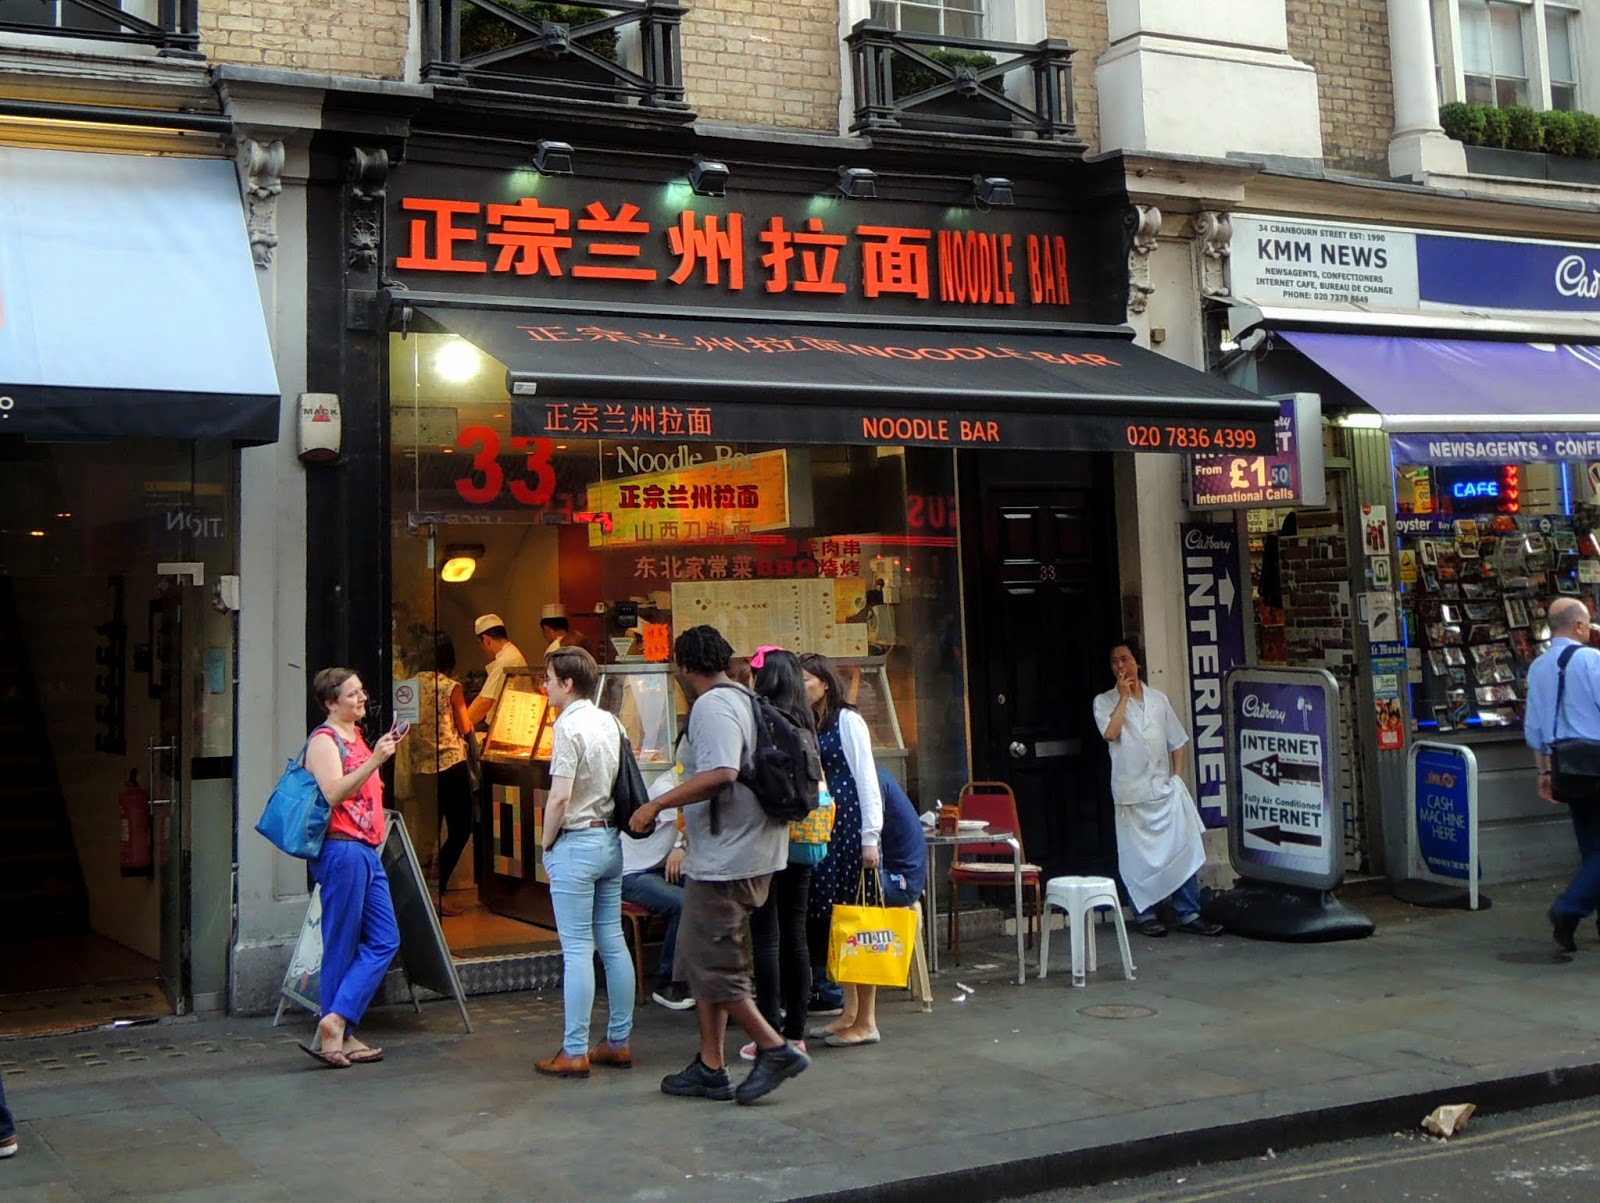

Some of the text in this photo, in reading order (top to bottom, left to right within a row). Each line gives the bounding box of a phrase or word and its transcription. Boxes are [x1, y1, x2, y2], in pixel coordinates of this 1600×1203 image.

[1258, 224, 1268, 232] 34
[1270, 225, 1318, 237] CRANBOURN
[1320, 229, 1347, 239] STREET
[1367, 234, 1386, 242] 1990
[396, 197, 1070, 305] 正宗兰州拉面 NOODLE BAR
[1257, 238, 1388, 269] KMM NEWS
[1256, 277, 1294, 287] INTERNET
[1296, 281, 1317, 290] CAFE,
[1319, 282, 1350, 292] BUREAU
[1363, 286, 1393, 295] CHANGE
[1265, 267, 1383, 283] NEWSAGENTS, CONFECTIONERS
[1283, 290, 1312, 299] PHONE:
[1313, 292, 1328, 300] 020
[1330, 293, 1349, 303] 7379
[516, 324, 1122, 368] 正宗兰州拉面 NOODLE BAR
[302, 408, 339, 416] MACK
[544, 402, 712, 436] 正宗兰州拉面
[863, 417, 1000, 443] NOODLE BAR
[1127, 425, 1161, 447] 020
[1167, 427, 1209, 448] 7836
[1214, 429, 1257, 449] 4399
[617, 445, 703, 473] Noodle
[1429, 441, 1539, 458] NEWSAGENTS
[455, 425, 556, 505] 33
[1195, 465, 1222, 475] From
[618, 484, 759, 510] 正宗兰州拉面
[1197, 488, 1294, 504] International Calls
[1453, 482, 1499, 498] CAFE
[1396, 518, 1431, 534] oyster
[1185, 529, 1231, 552] Cadbury
[634, 555, 754, 579] 东北家常菜
[1186, 556, 1228, 817] INTERNET
[1242, 694, 1286, 724] Cadbury
[1243, 734, 1319, 756] INTERNET
[1262, 796, 1273, 804] Air
[1275, 797, 1322, 811] Conditioned
[1427, 794, 1454, 812] CASH
[1245, 804, 1322, 828] INTERNET
[1420, 808, 1466, 829] MACHINE
[1432, 825, 1457, 842] HERE
